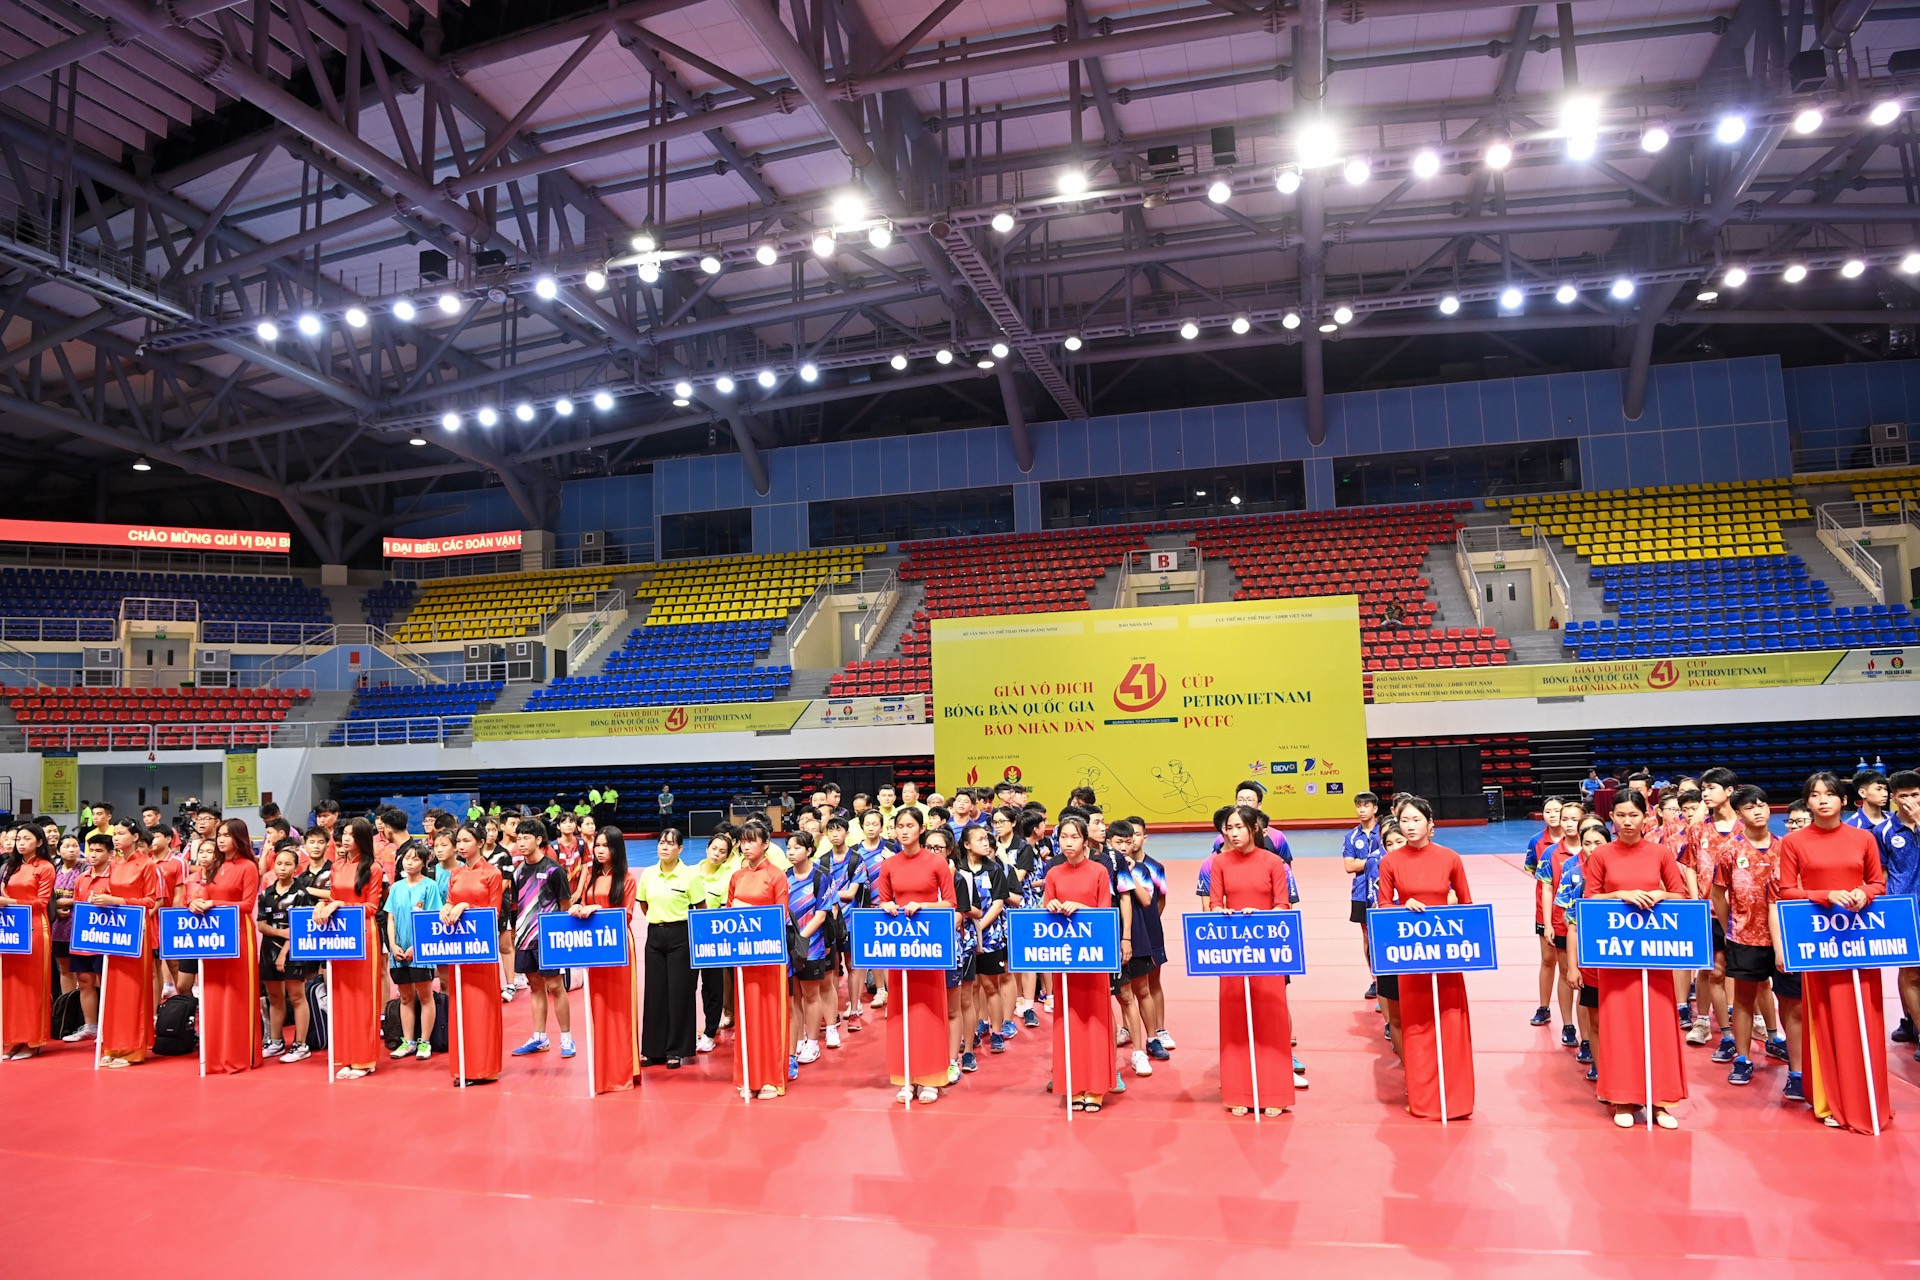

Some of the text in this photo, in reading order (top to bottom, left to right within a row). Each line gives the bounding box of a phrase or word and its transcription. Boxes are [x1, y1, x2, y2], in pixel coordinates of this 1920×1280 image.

[128, 529, 168, 542] CHÀO
[170, 531, 212, 545] MỪNG
[214, 533, 237, 546] QUÍ
[239, 535, 252, 549] VỊ
[254, 536, 276, 550] ĐẠI
[392, 542, 411, 555] ĐẠI
[442, 538, 463, 551] CÁC
[465, 536, 493, 549] ĐOÀN
[495, 535, 516, 548] VẬN
[1158, 555, 1170, 568] B
[1575, 663, 1595, 674] GIẢI
[1614, 663, 1638, 672] ĐỊCH
[1651, 660, 1673, 682] 41
[1686, 658, 1707, 668] CÚP
[1688, 667, 1767, 678] PETROVIETNAM
[1119, 663, 1156, 700] 41
[1181, 673, 1214, 689] CÚP
[1543, 672, 1639, 684] BÓNG BÀN QUỐC GIA
[1568, 681, 1640, 692] BÁO NHÂN DÂN
[1689, 678, 1720, 687] PVCFC
[994, 681, 1094, 698] GIẢI VÔ ĐỊCH
[1183, 690, 1312, 708] PETROVIETNAM
[668, 707, 684, 725] 41
[694, 706, 709, 715] CÚP
[694, 713, 752, 722] PETROVIETNAM
[944, 699, 1095, 718] BÓNG BÀN QUỐC GIA
[590, 718, 609, 727] BÓNG
[611, 718, 625, 726] BÀN
[626, 717, 646, 726] QUỐC
[608, 724, 660, 734] BÁO NHÂN DÂN
[984, 717, 1095, 736] BÁO NHÂN DÂN
[1183, 714, 1234, 729] PVCFC
[88, 910, 127, 927] ĐOÀN
[711, 913, 762, 935] ĐOÀN
[874, 916, 930, 937] ĐOÀN
[1397, 914, 1464, 938] ĐOÀN
[81, 927, 132, 946] ĐỒNG NAI
[1033, 918, 1093, 939] ĐOÀN
[1195, 920, 1290, 943] CÂU LẠC BỘ
[173, 932, 225, 950] HÀ NỘI
[298, 933, 356, 951] HẢI PHÒNG
[421, 937, 490, 957] KHÁNH HÒA
[548, 926, 617, 952] TRỌNG TÀI
[694, 942, 716, 958] LONG
[717, 938, 732, 957] HẢI
[738, 937, 752, 956] HẢI
[753, 939, 781, 955] DƯƠNG
[864, 938, 942, 958] LÂM ĐỒNG
[1596, 936, 1694, 957] TÂY NINH
[1798, 935, 1908, 959] TP HỒ CHÍ MINH
[1024, 943, 1104, 965] NGHỆ AN
[1197, 944, 1293, 965] NGUYÊN VÕ
[1386, 939, 1480, 963] QUÂN ĐỘI
